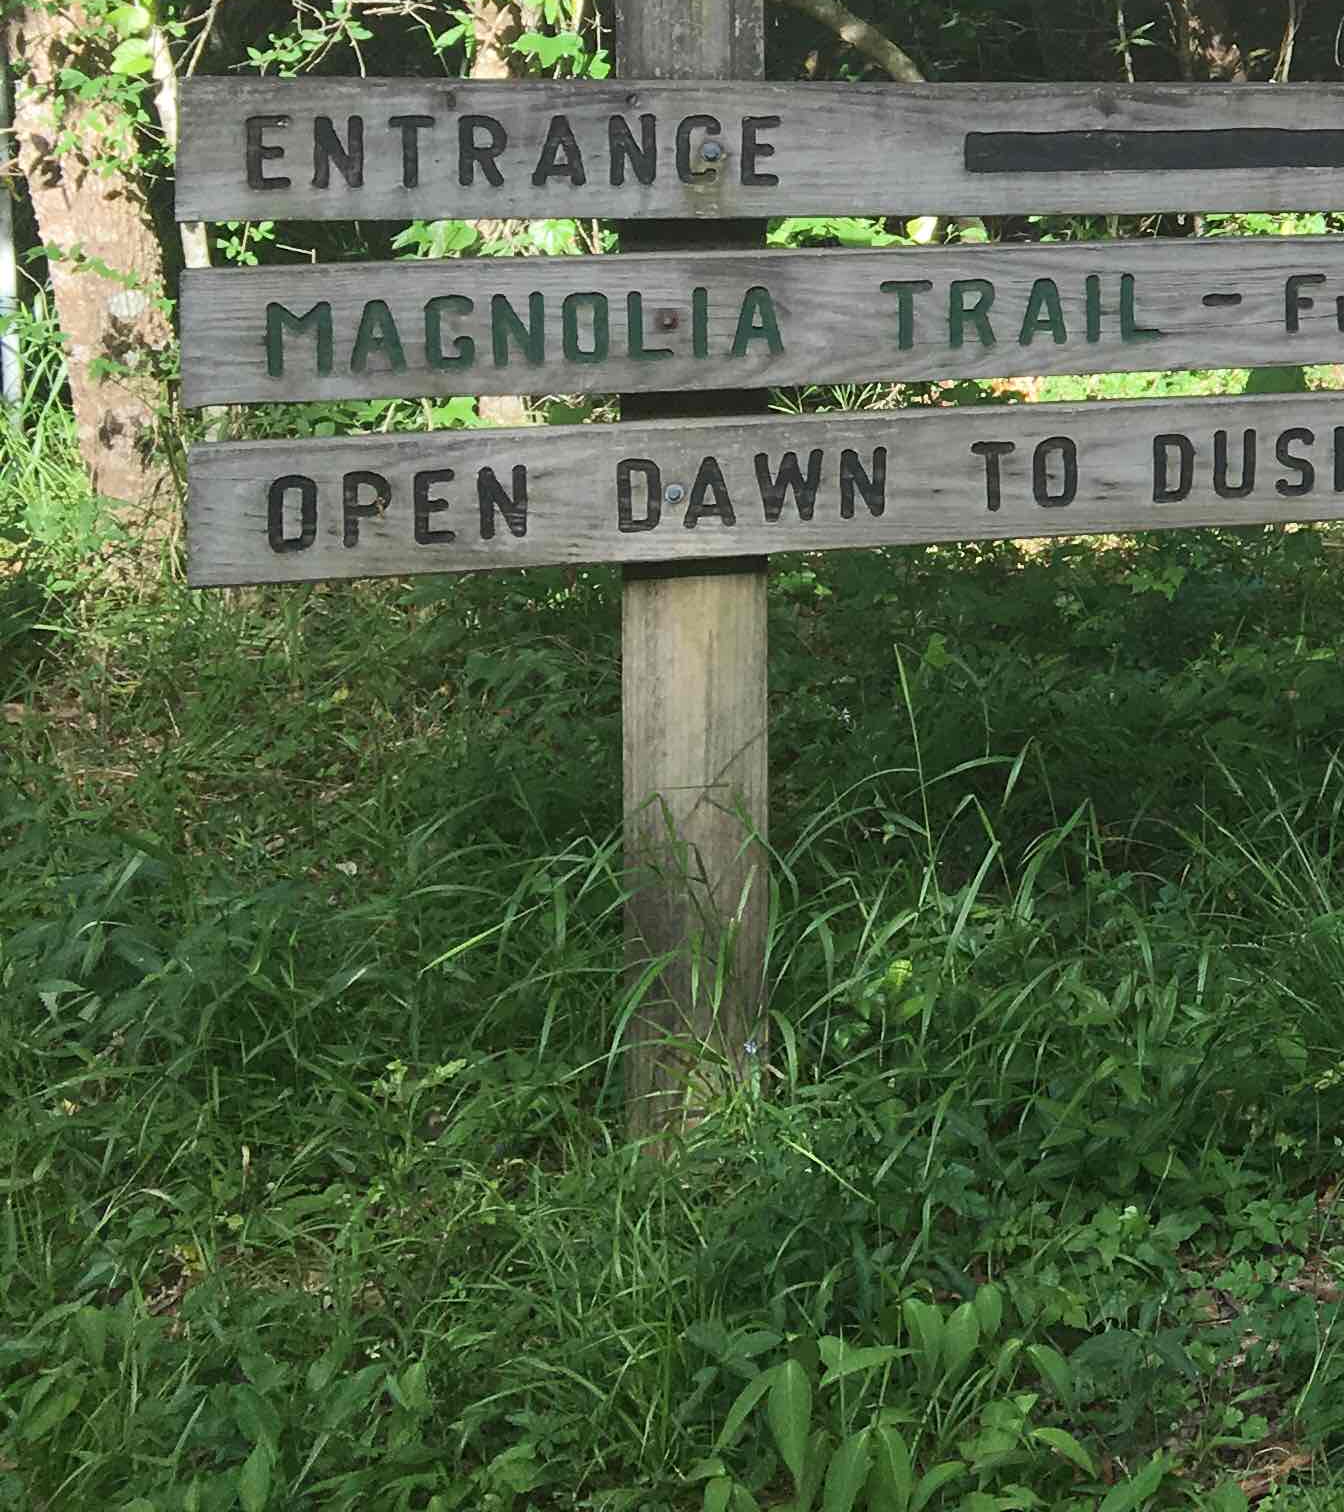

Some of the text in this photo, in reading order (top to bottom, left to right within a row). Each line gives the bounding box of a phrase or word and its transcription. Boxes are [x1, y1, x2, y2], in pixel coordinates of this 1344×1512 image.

[245, 114, 782, 189] ENTRANCE
[264, 285, 785, 378] MAGNOLIA
[880, 273, 1160, 350] TRAIL
[266, 464, 528, 554] OPEN
[616, 445, 888, 534] DAWN
[971, 436, 1079, 512] TO
